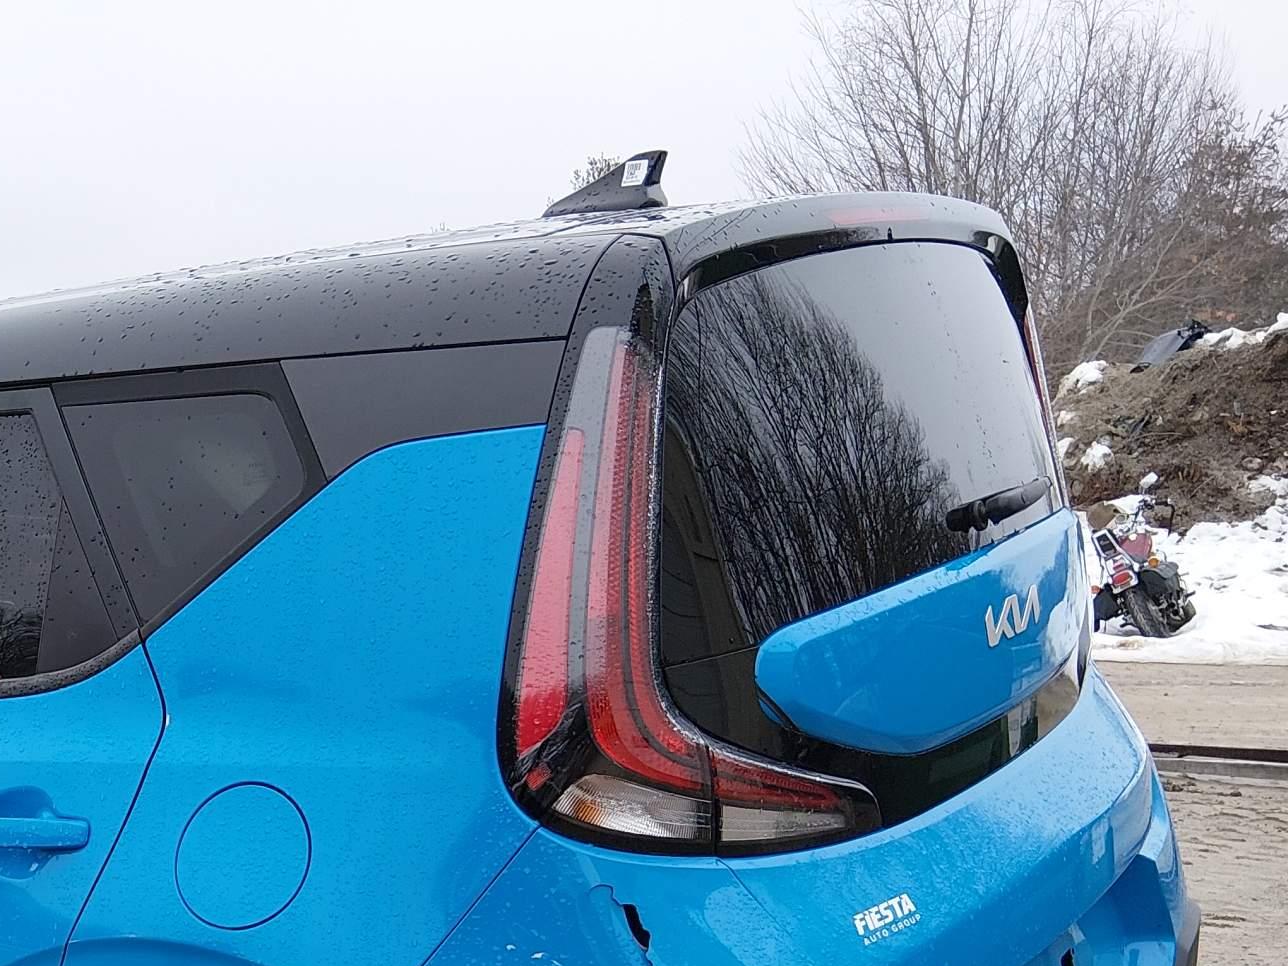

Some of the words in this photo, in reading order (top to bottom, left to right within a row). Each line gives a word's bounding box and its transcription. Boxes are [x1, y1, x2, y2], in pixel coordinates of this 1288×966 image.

[853, 893, 917, 936] FIESTA
[863, 928, 890, 946] AUTO
[891, 913, 922, 933] GROUP
